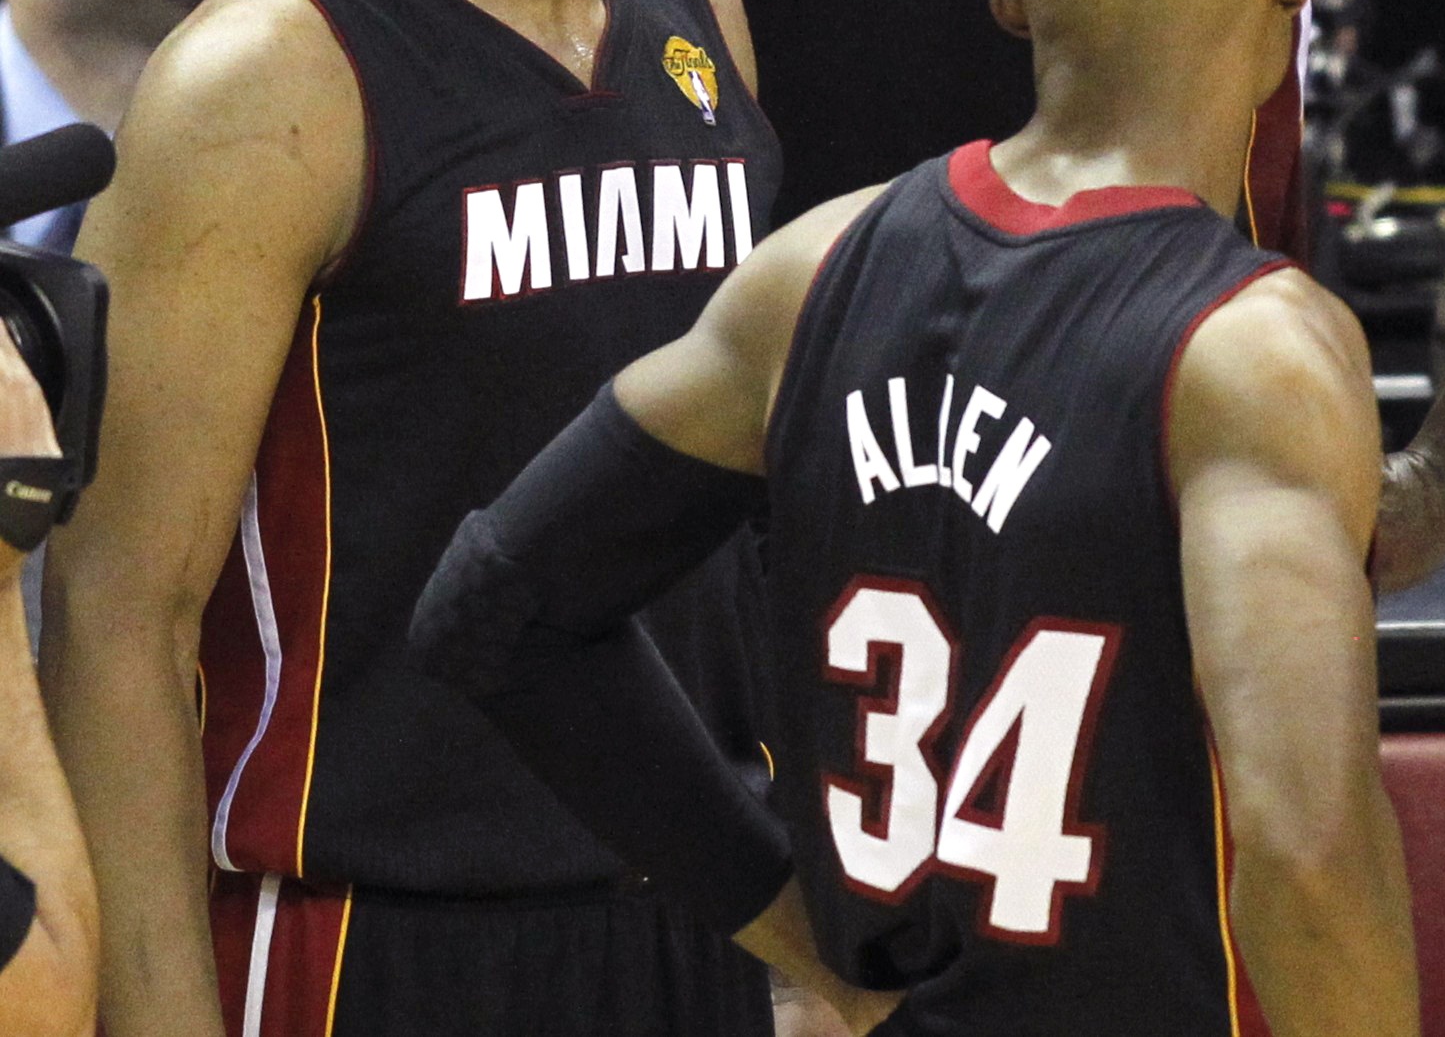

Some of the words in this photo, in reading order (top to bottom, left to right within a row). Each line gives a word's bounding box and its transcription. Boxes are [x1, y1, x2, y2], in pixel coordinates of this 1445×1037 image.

[460, 159, 754, 304] MIAMI
[846, 373, 1053, 535] ALLEN
[822, 578, 1115, 941] 34
